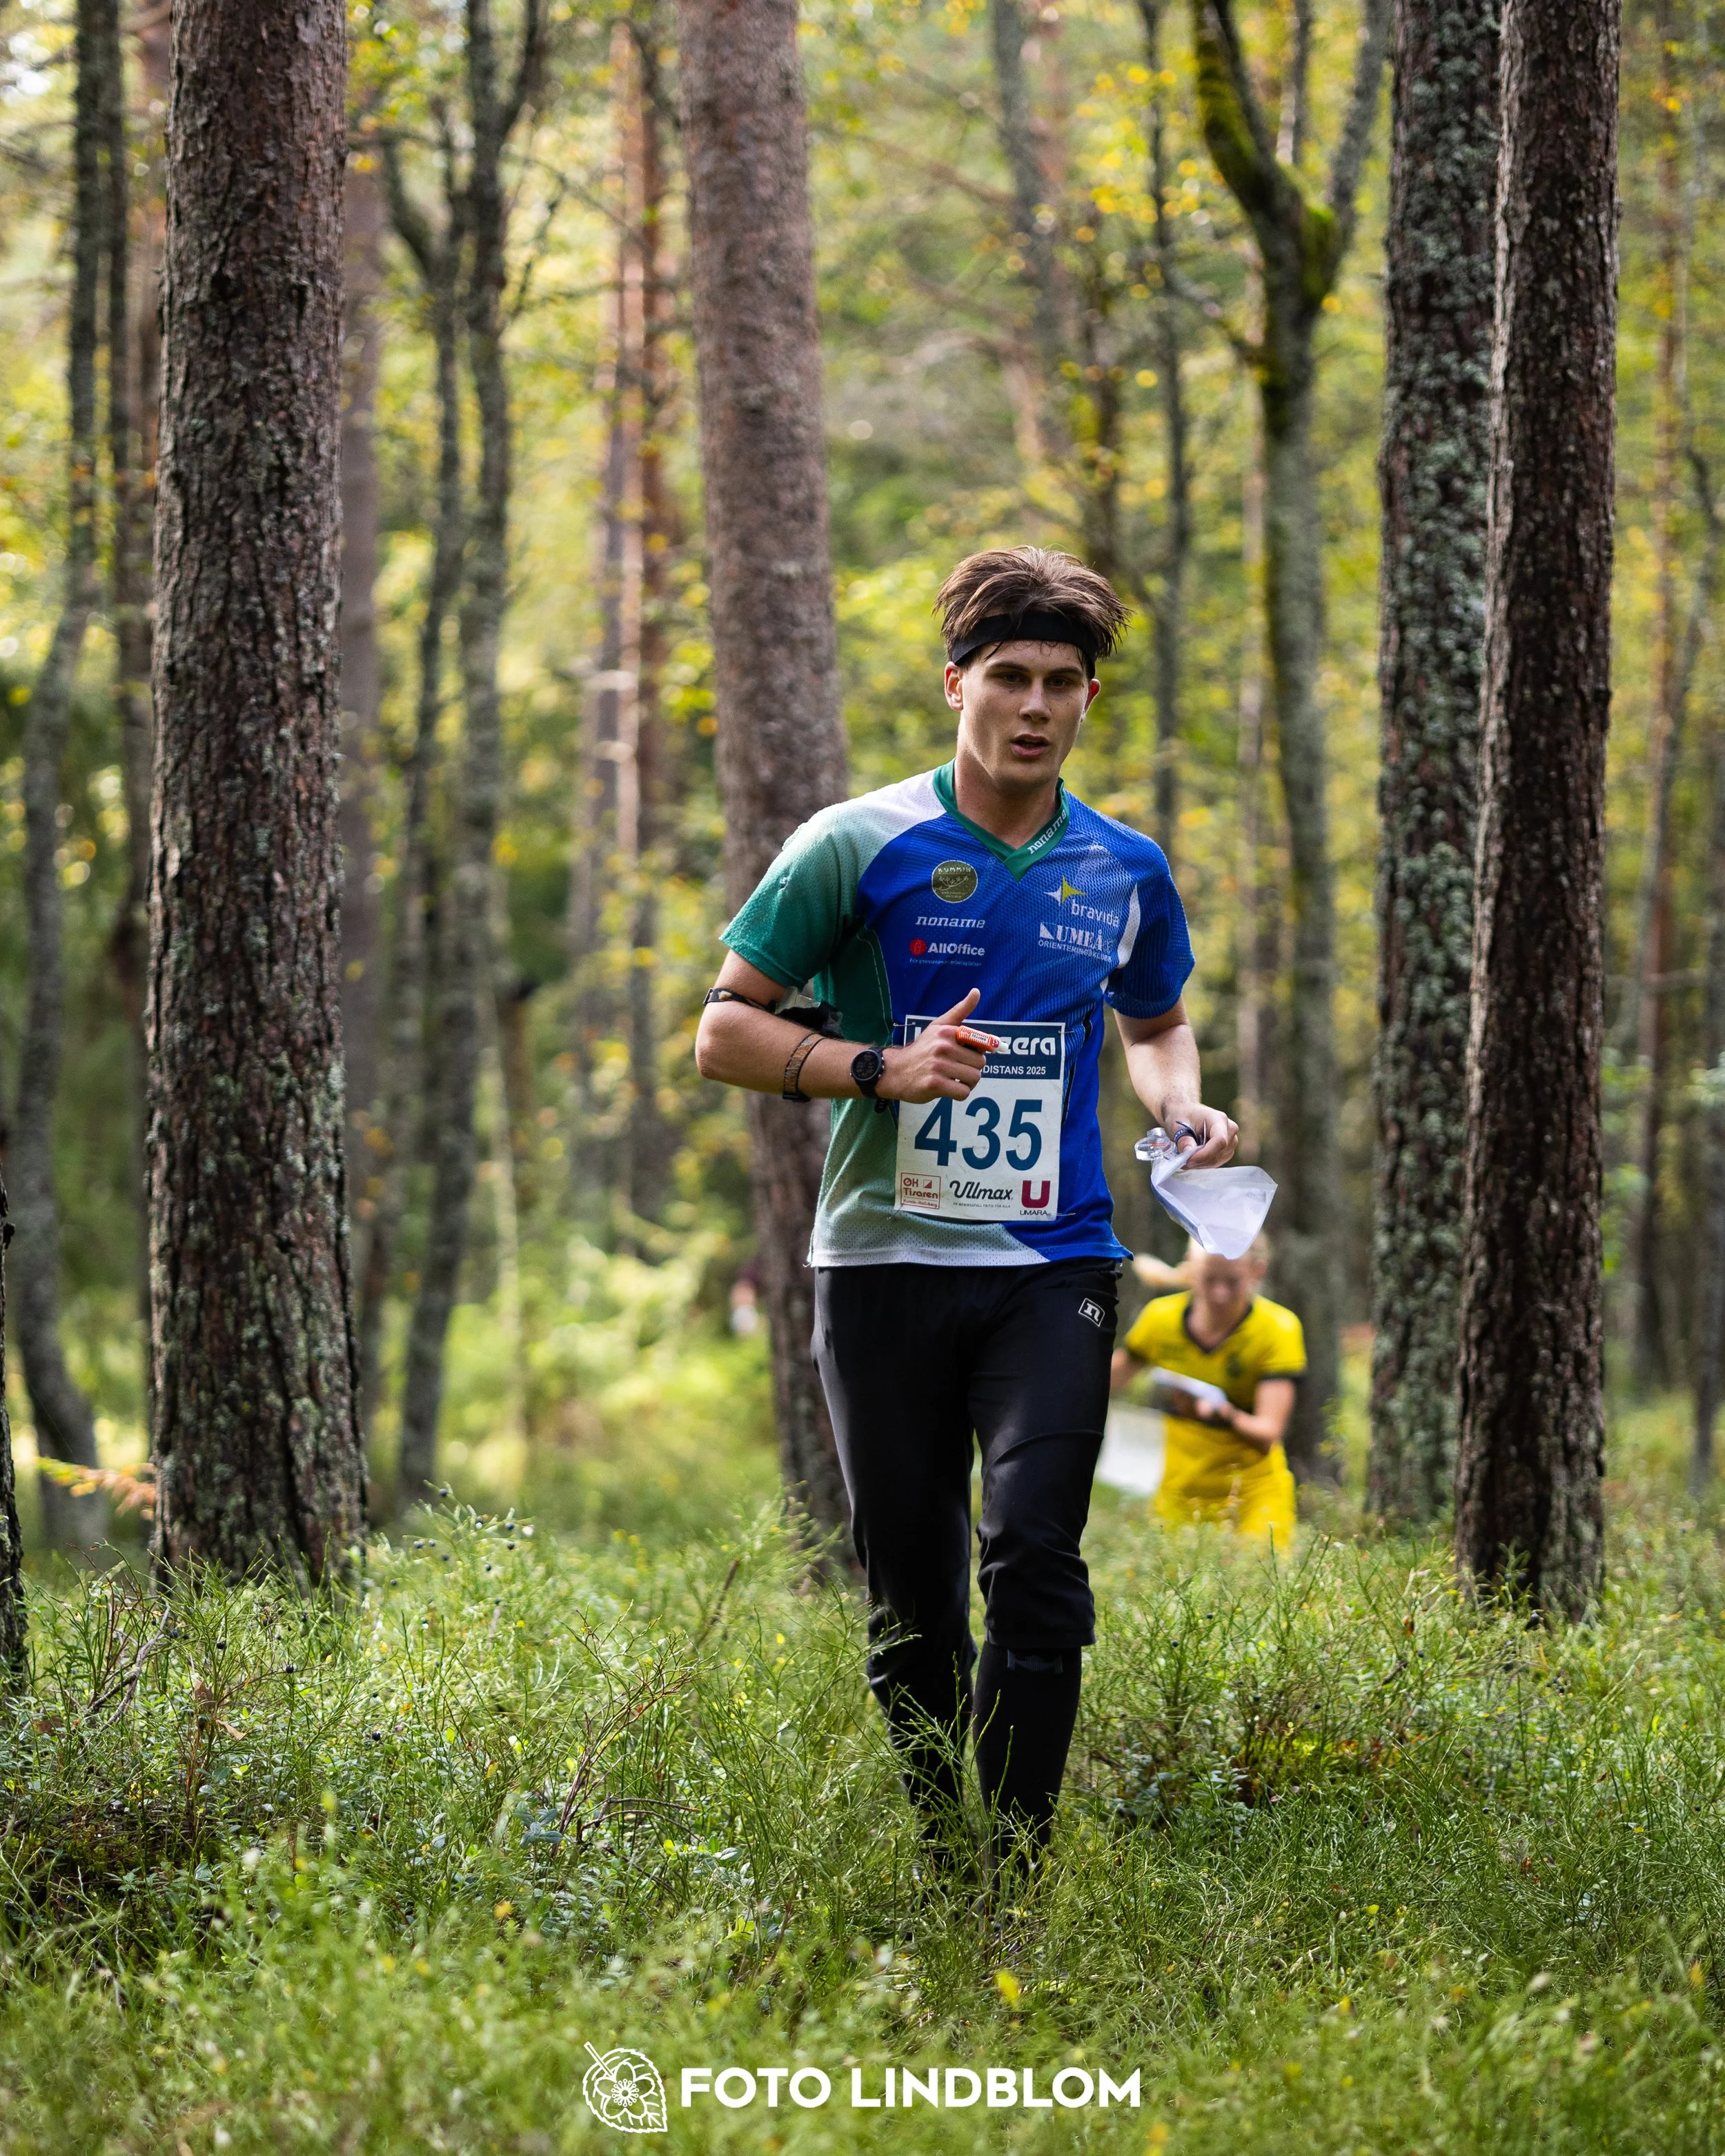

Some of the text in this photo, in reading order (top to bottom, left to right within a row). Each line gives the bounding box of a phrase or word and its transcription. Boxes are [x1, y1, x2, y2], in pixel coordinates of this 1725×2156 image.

[1027, 809, 1066, 854] noname
[915, 916, 985, 928] noname
[1072, 898, 1119, 928] bravida
[1056, 924, 1103, 951] UMEÅ
[927, 942, 985, 956] AllOffice
[980, 1065, 1046, 1075] DISTANS 2025
[914, 1096, 1043, 1171] 435
[903, 1187, 938, 1199] Tisaren
[949, 1180, 1013, 1200] Ullmax
